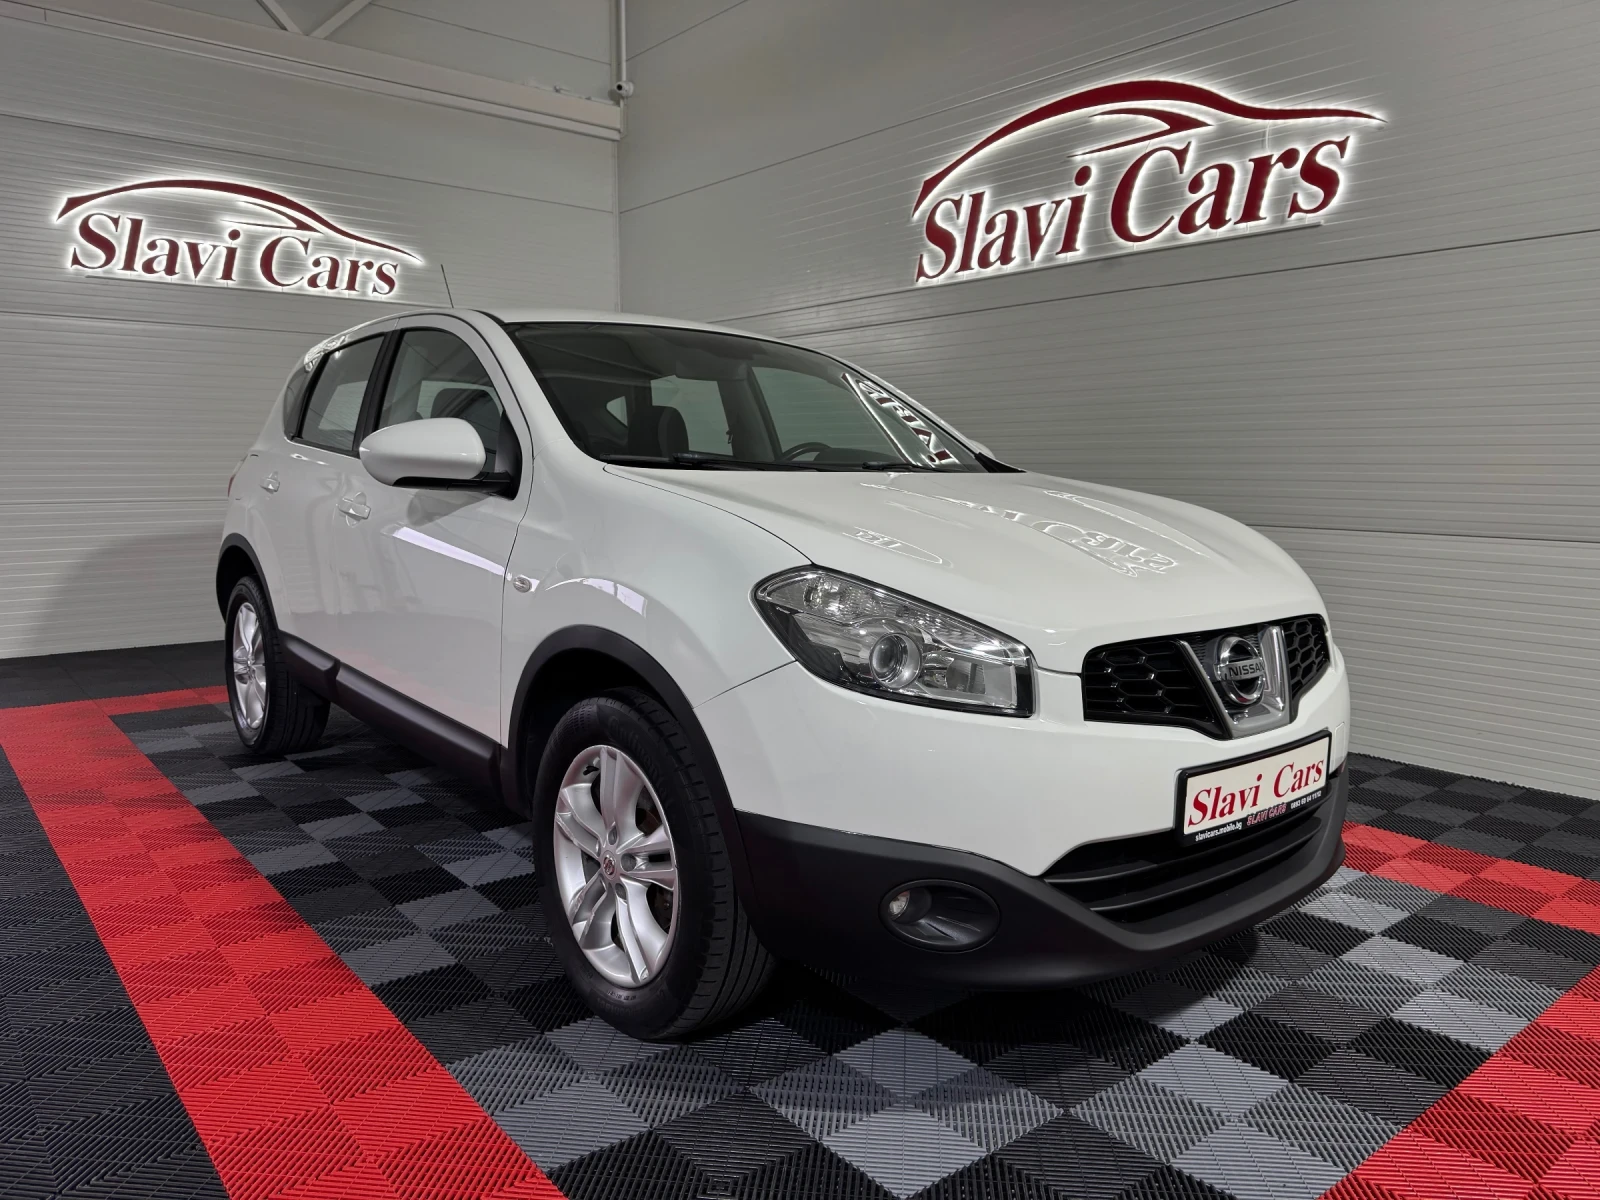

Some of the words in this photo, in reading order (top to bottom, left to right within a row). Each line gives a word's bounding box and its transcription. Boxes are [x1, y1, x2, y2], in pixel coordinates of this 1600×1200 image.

[915, 166, 1092, 282] Slavi
[1110, 136, 1350, 243] Cars
[70, 212, 241, 282] Slavi
[259, 235, 399, 296] Cars
[1229, 661, 1266, 677] NISSAN
[1188, 773, 1263, 827] Slavi
[1273, 759, 1325, 798] Cars
[1195, 820, 1243, 841] slavicars.mobile.bg
[1246, 810, 1268, 826] SLAVI
[1268, 803, 1287, 818] CARS
